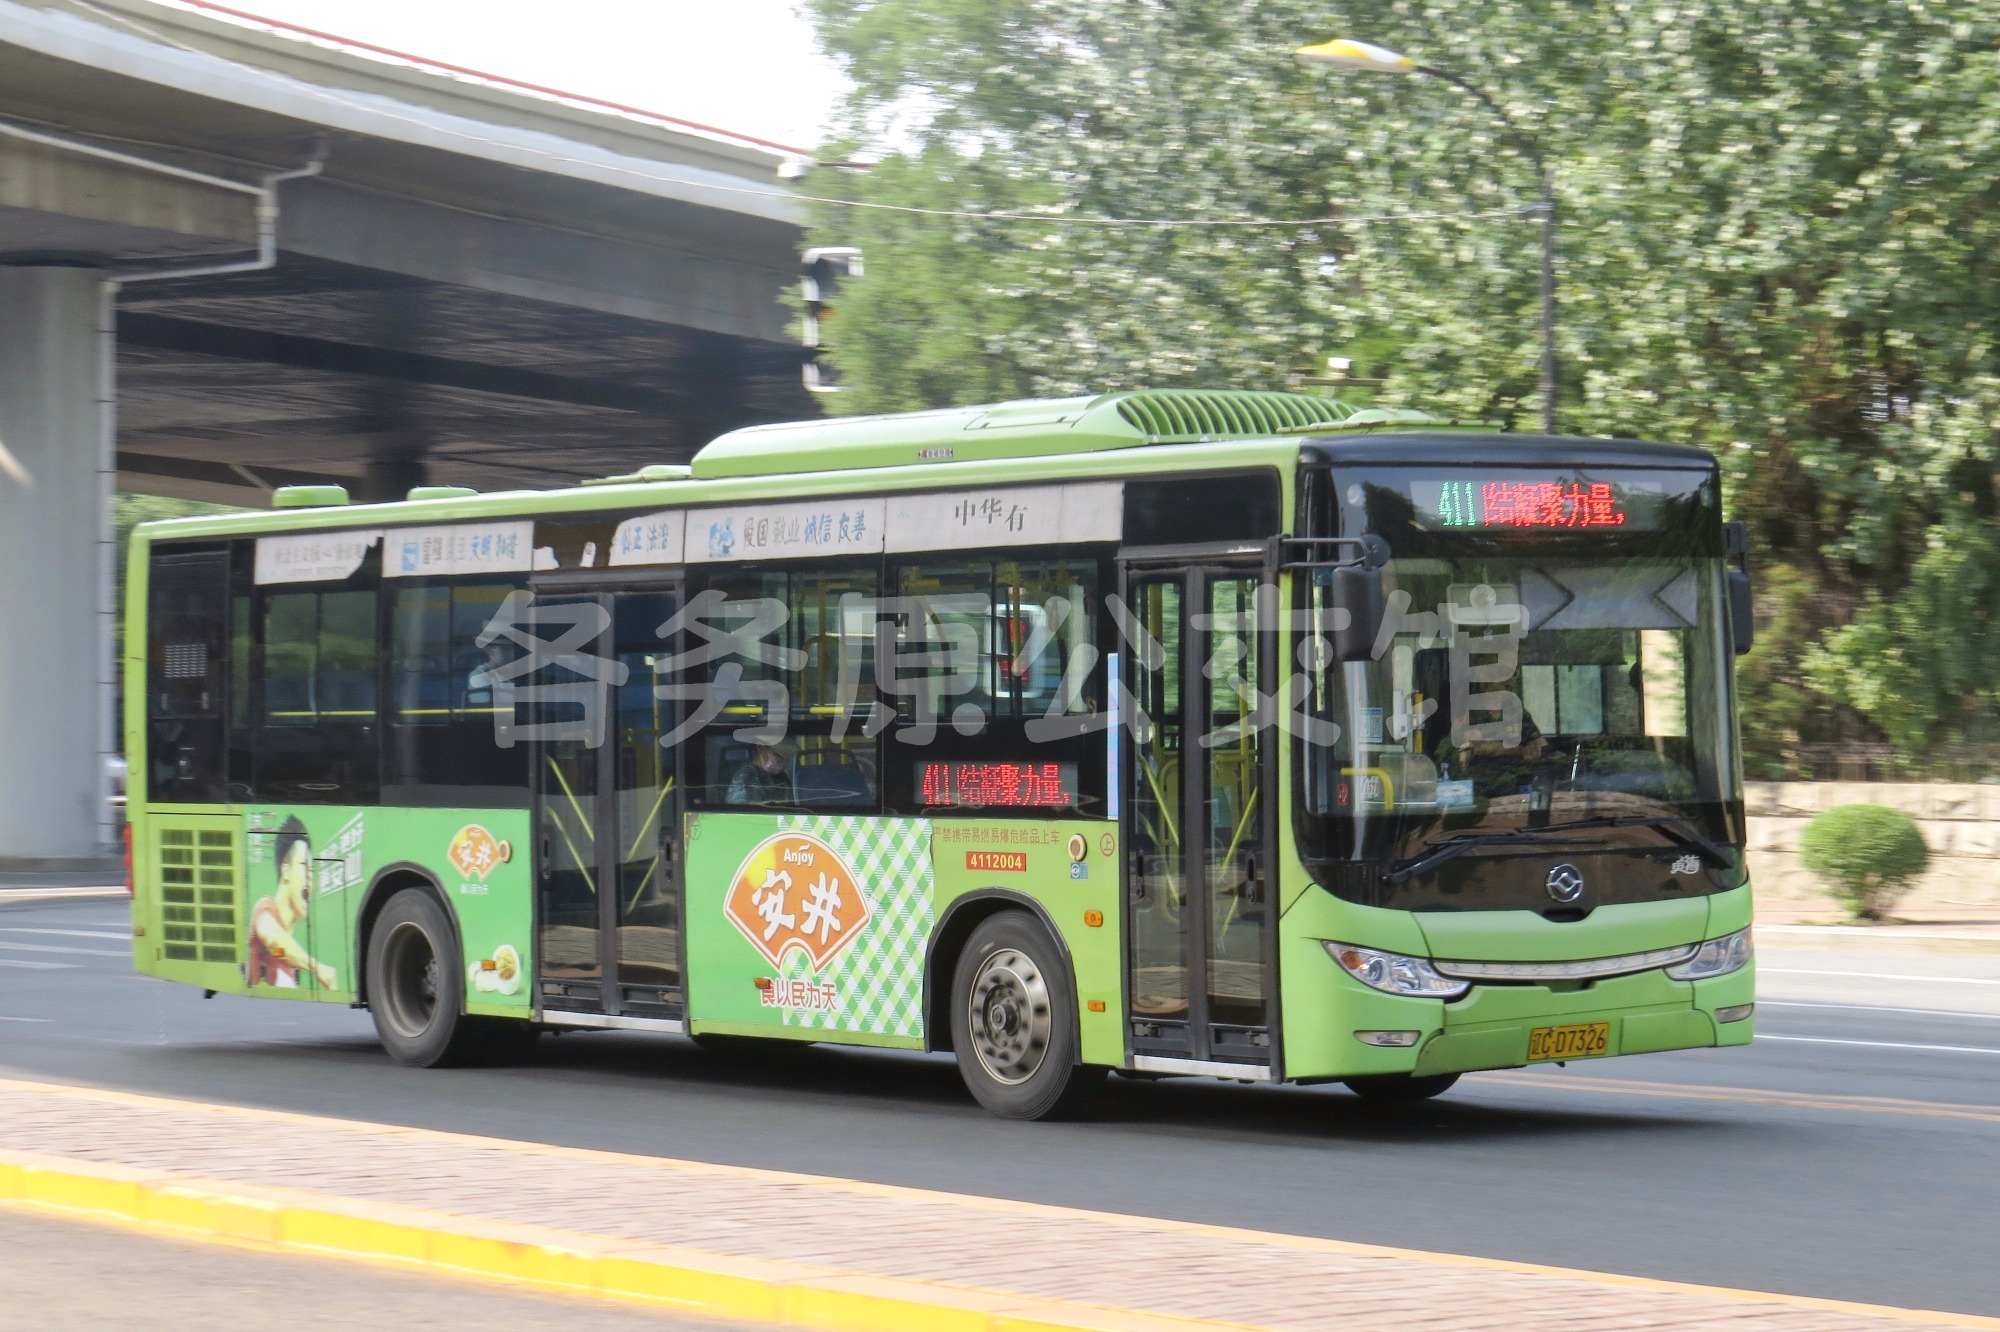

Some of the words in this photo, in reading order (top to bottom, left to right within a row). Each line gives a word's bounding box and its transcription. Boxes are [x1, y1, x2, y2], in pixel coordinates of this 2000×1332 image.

[1438, 481, 1477, 526] 411
[922, 763, 952, 806] 411
[783, 843, 814, 866] Anjoy
[970, 853, 1022, 869] 4112004
[751, 868, 842, 945] 安井
